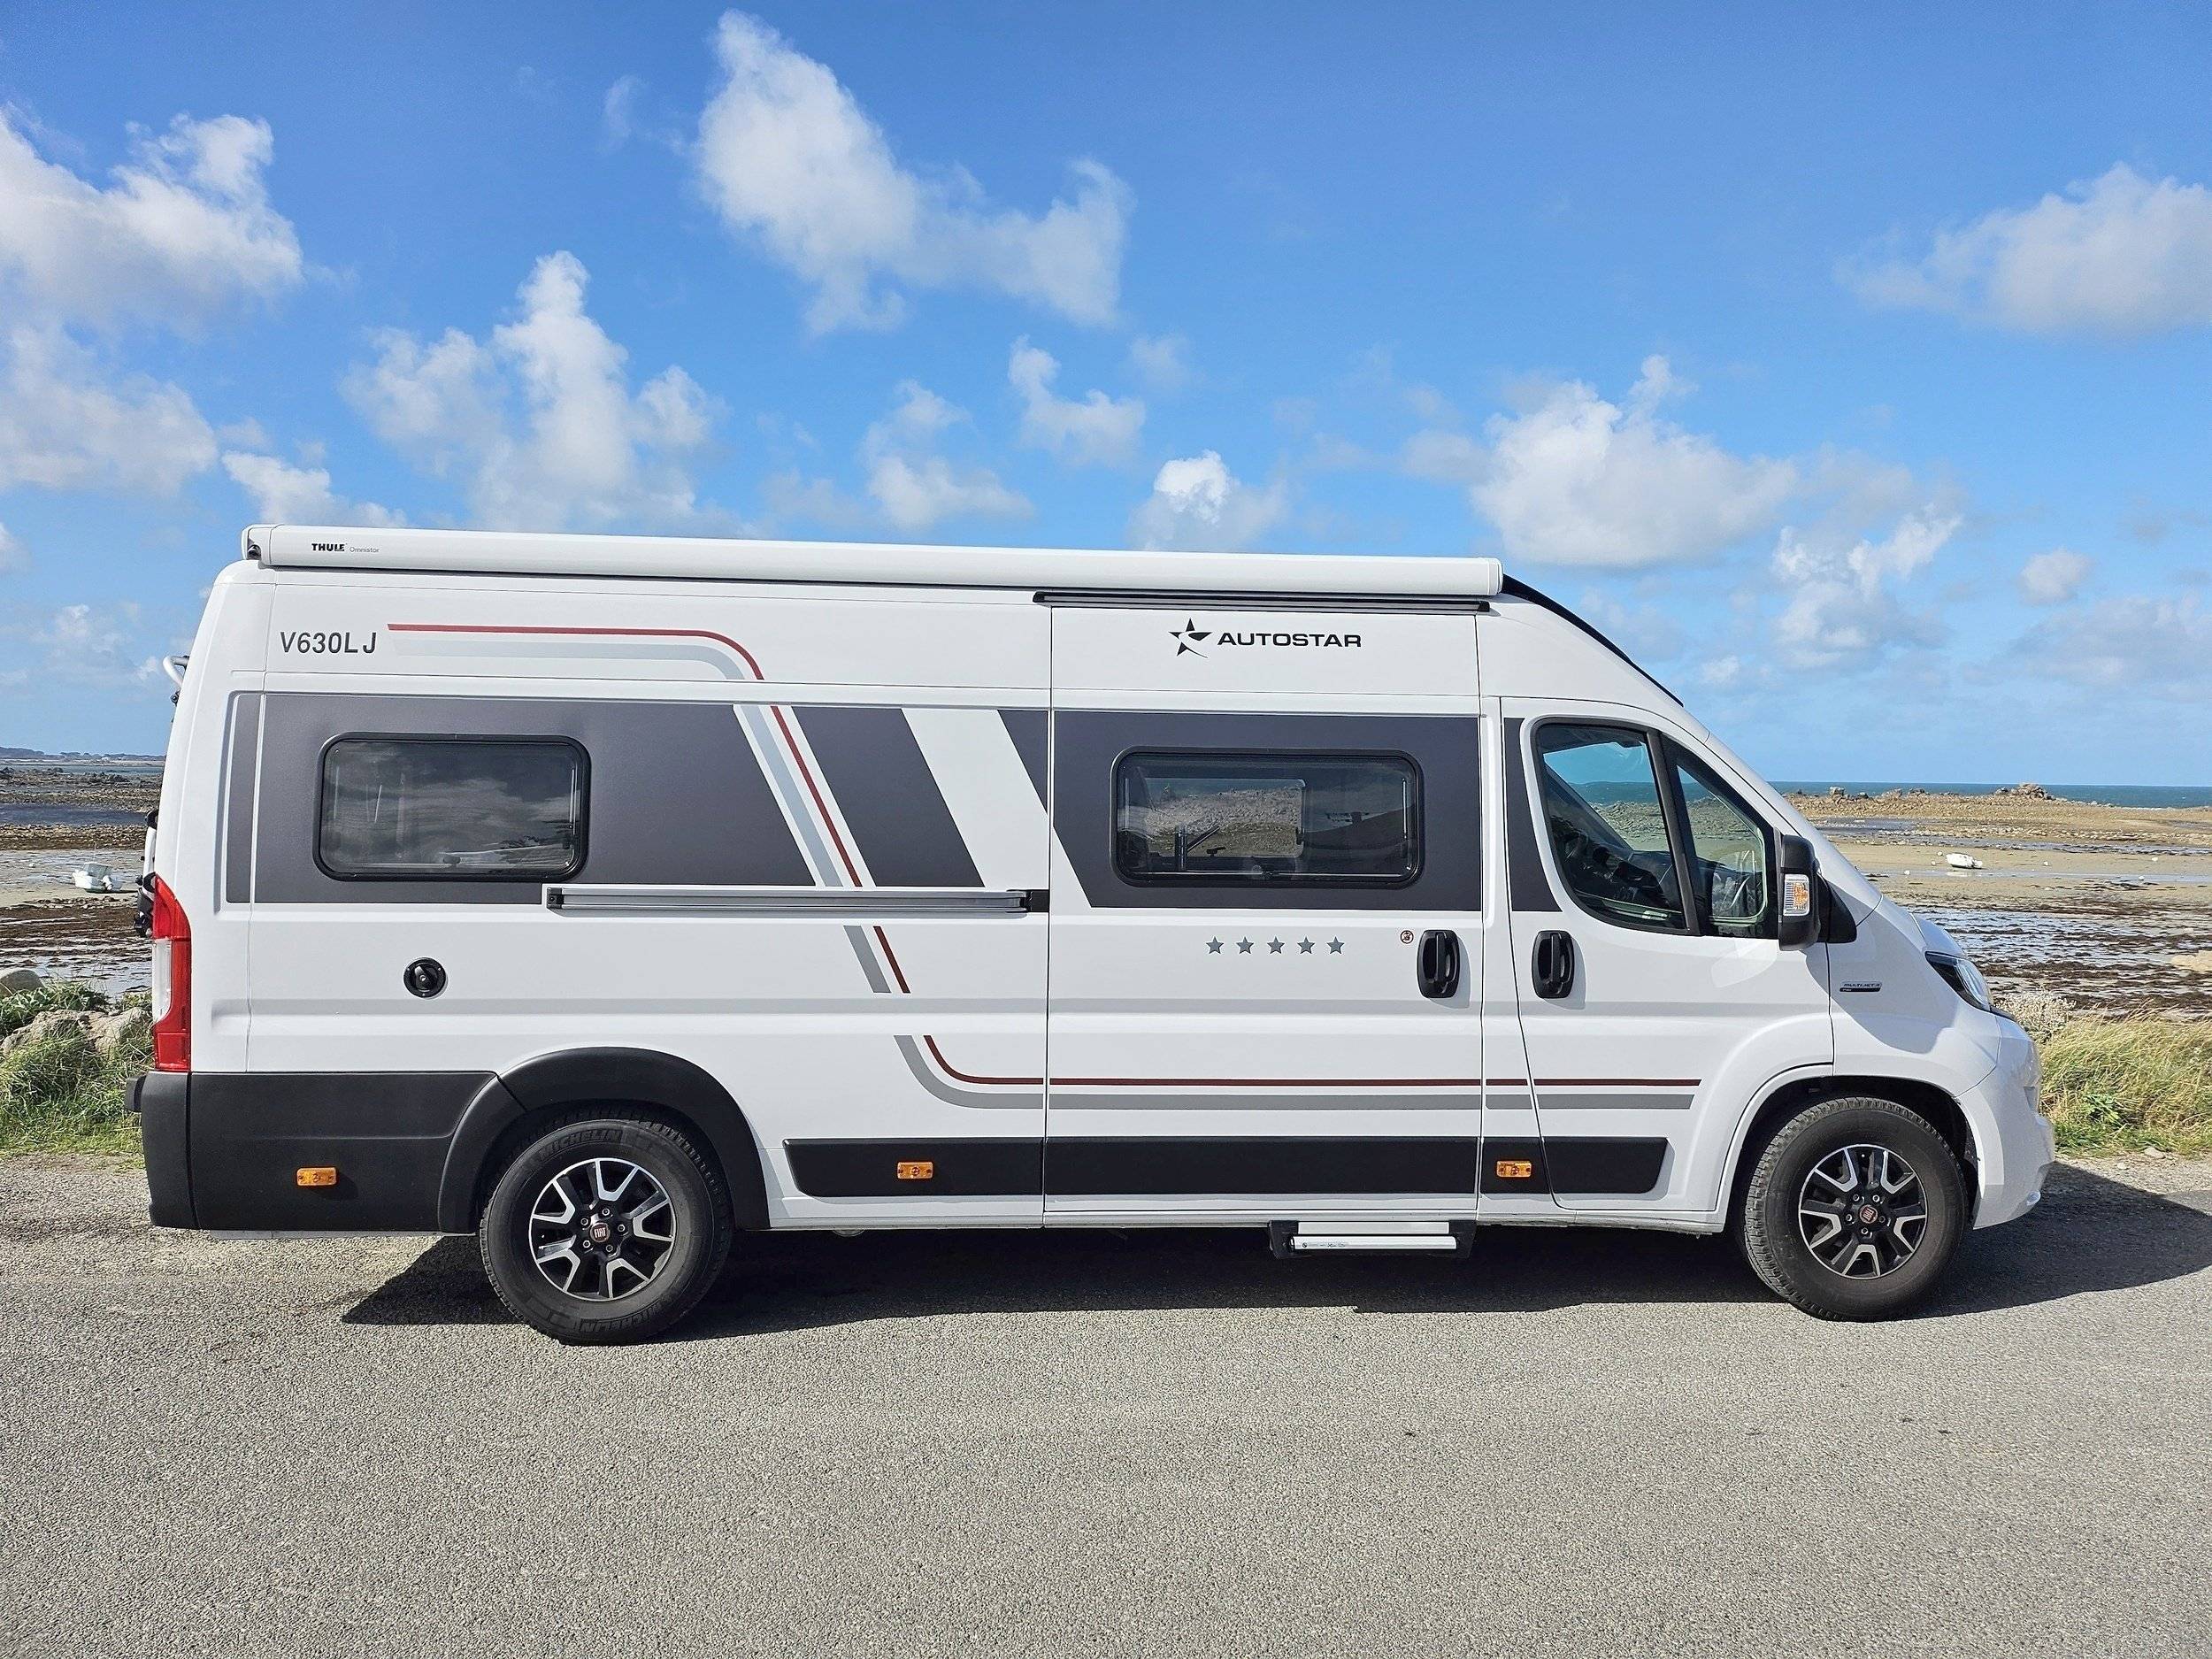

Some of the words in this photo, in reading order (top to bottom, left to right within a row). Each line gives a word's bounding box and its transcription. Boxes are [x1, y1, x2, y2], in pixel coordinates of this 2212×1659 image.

[311, 543, 345, 552] THULE
[280, 631, 377, 654] V630LJ
[1217, 632, 1362, 648] AUTOSTAR
[538, 1129, 623, 1162] MICHELIN
[594, 1227, 606, 1239] FIAT
